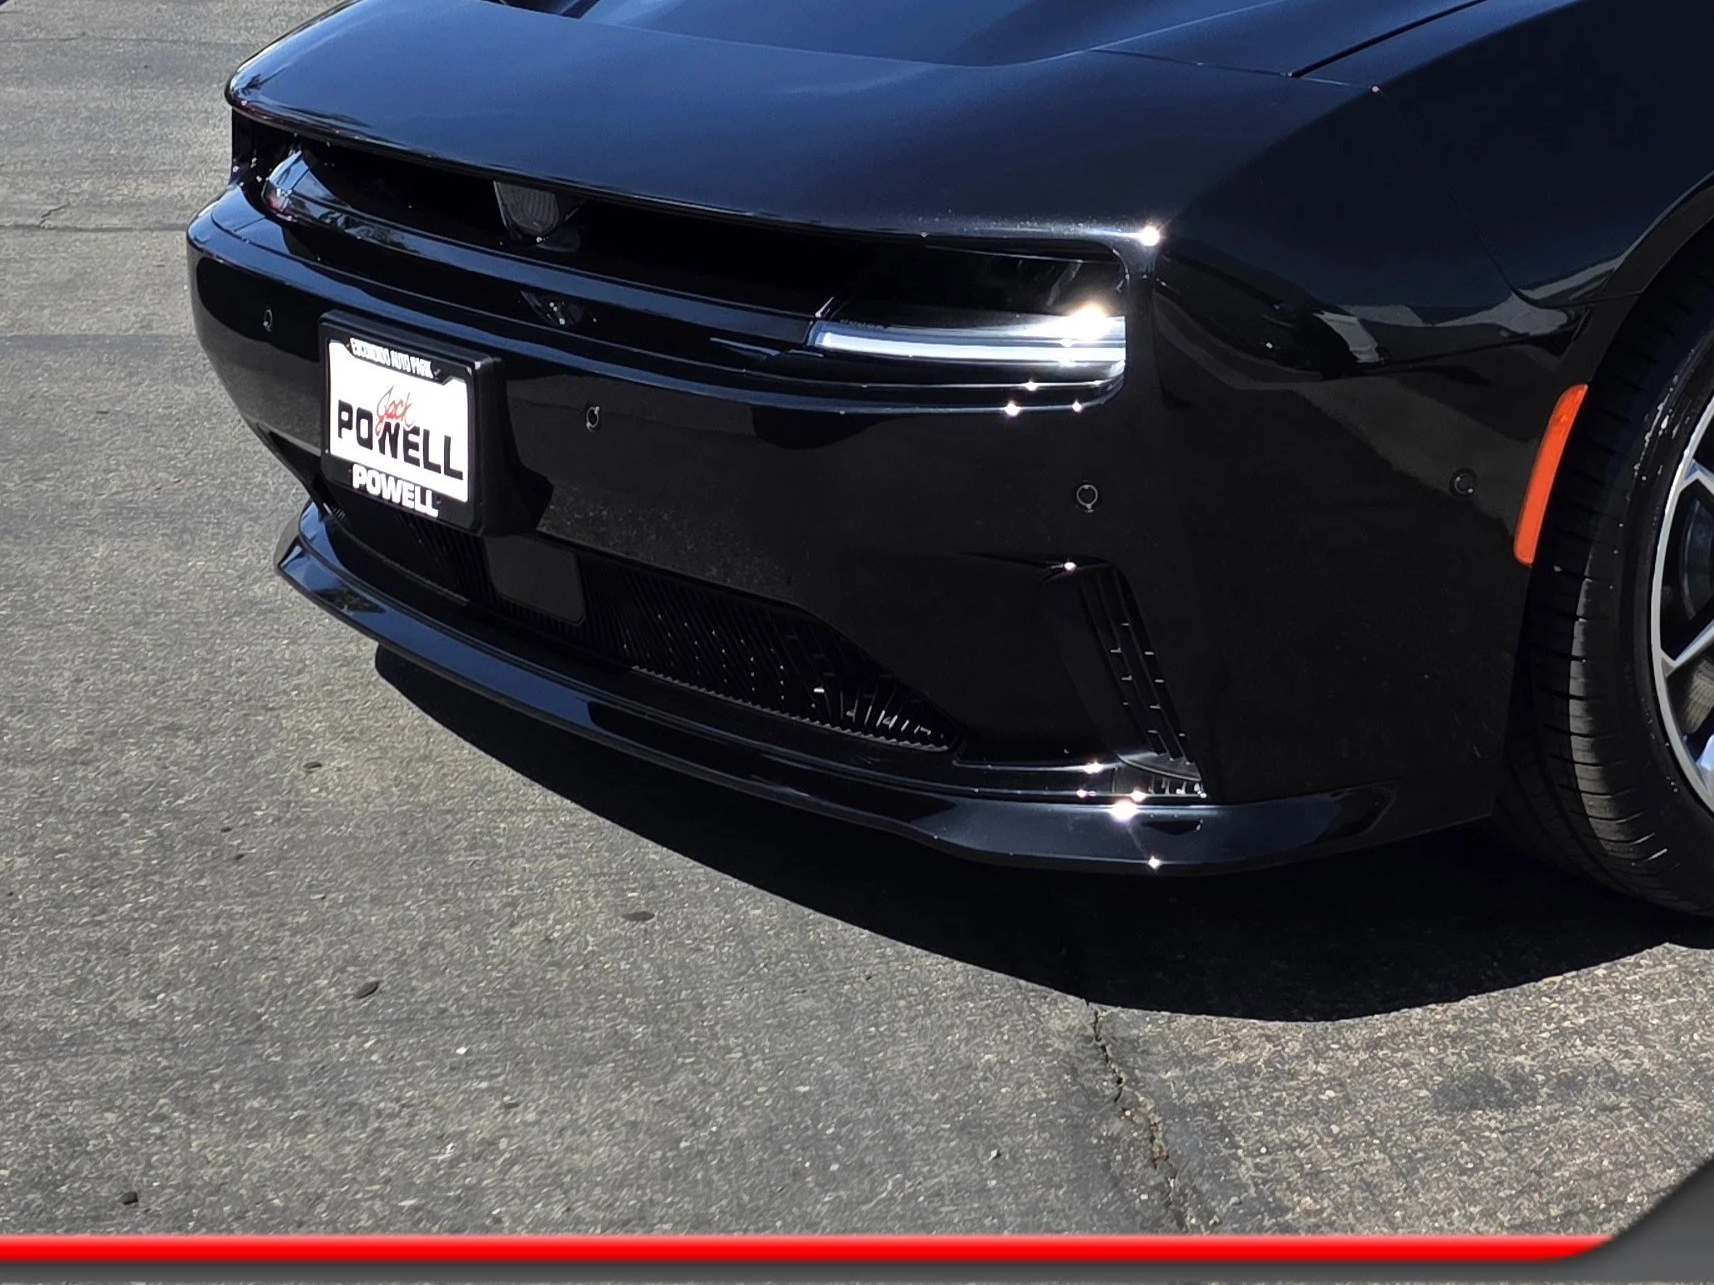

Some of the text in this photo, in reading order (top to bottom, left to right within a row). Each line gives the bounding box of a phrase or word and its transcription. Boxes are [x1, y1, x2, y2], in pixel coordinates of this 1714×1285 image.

[375, 386, 415, 436] Jack
[338, 399, 464, 481] POWELL
[352, 463, 439, 518] POWELL
